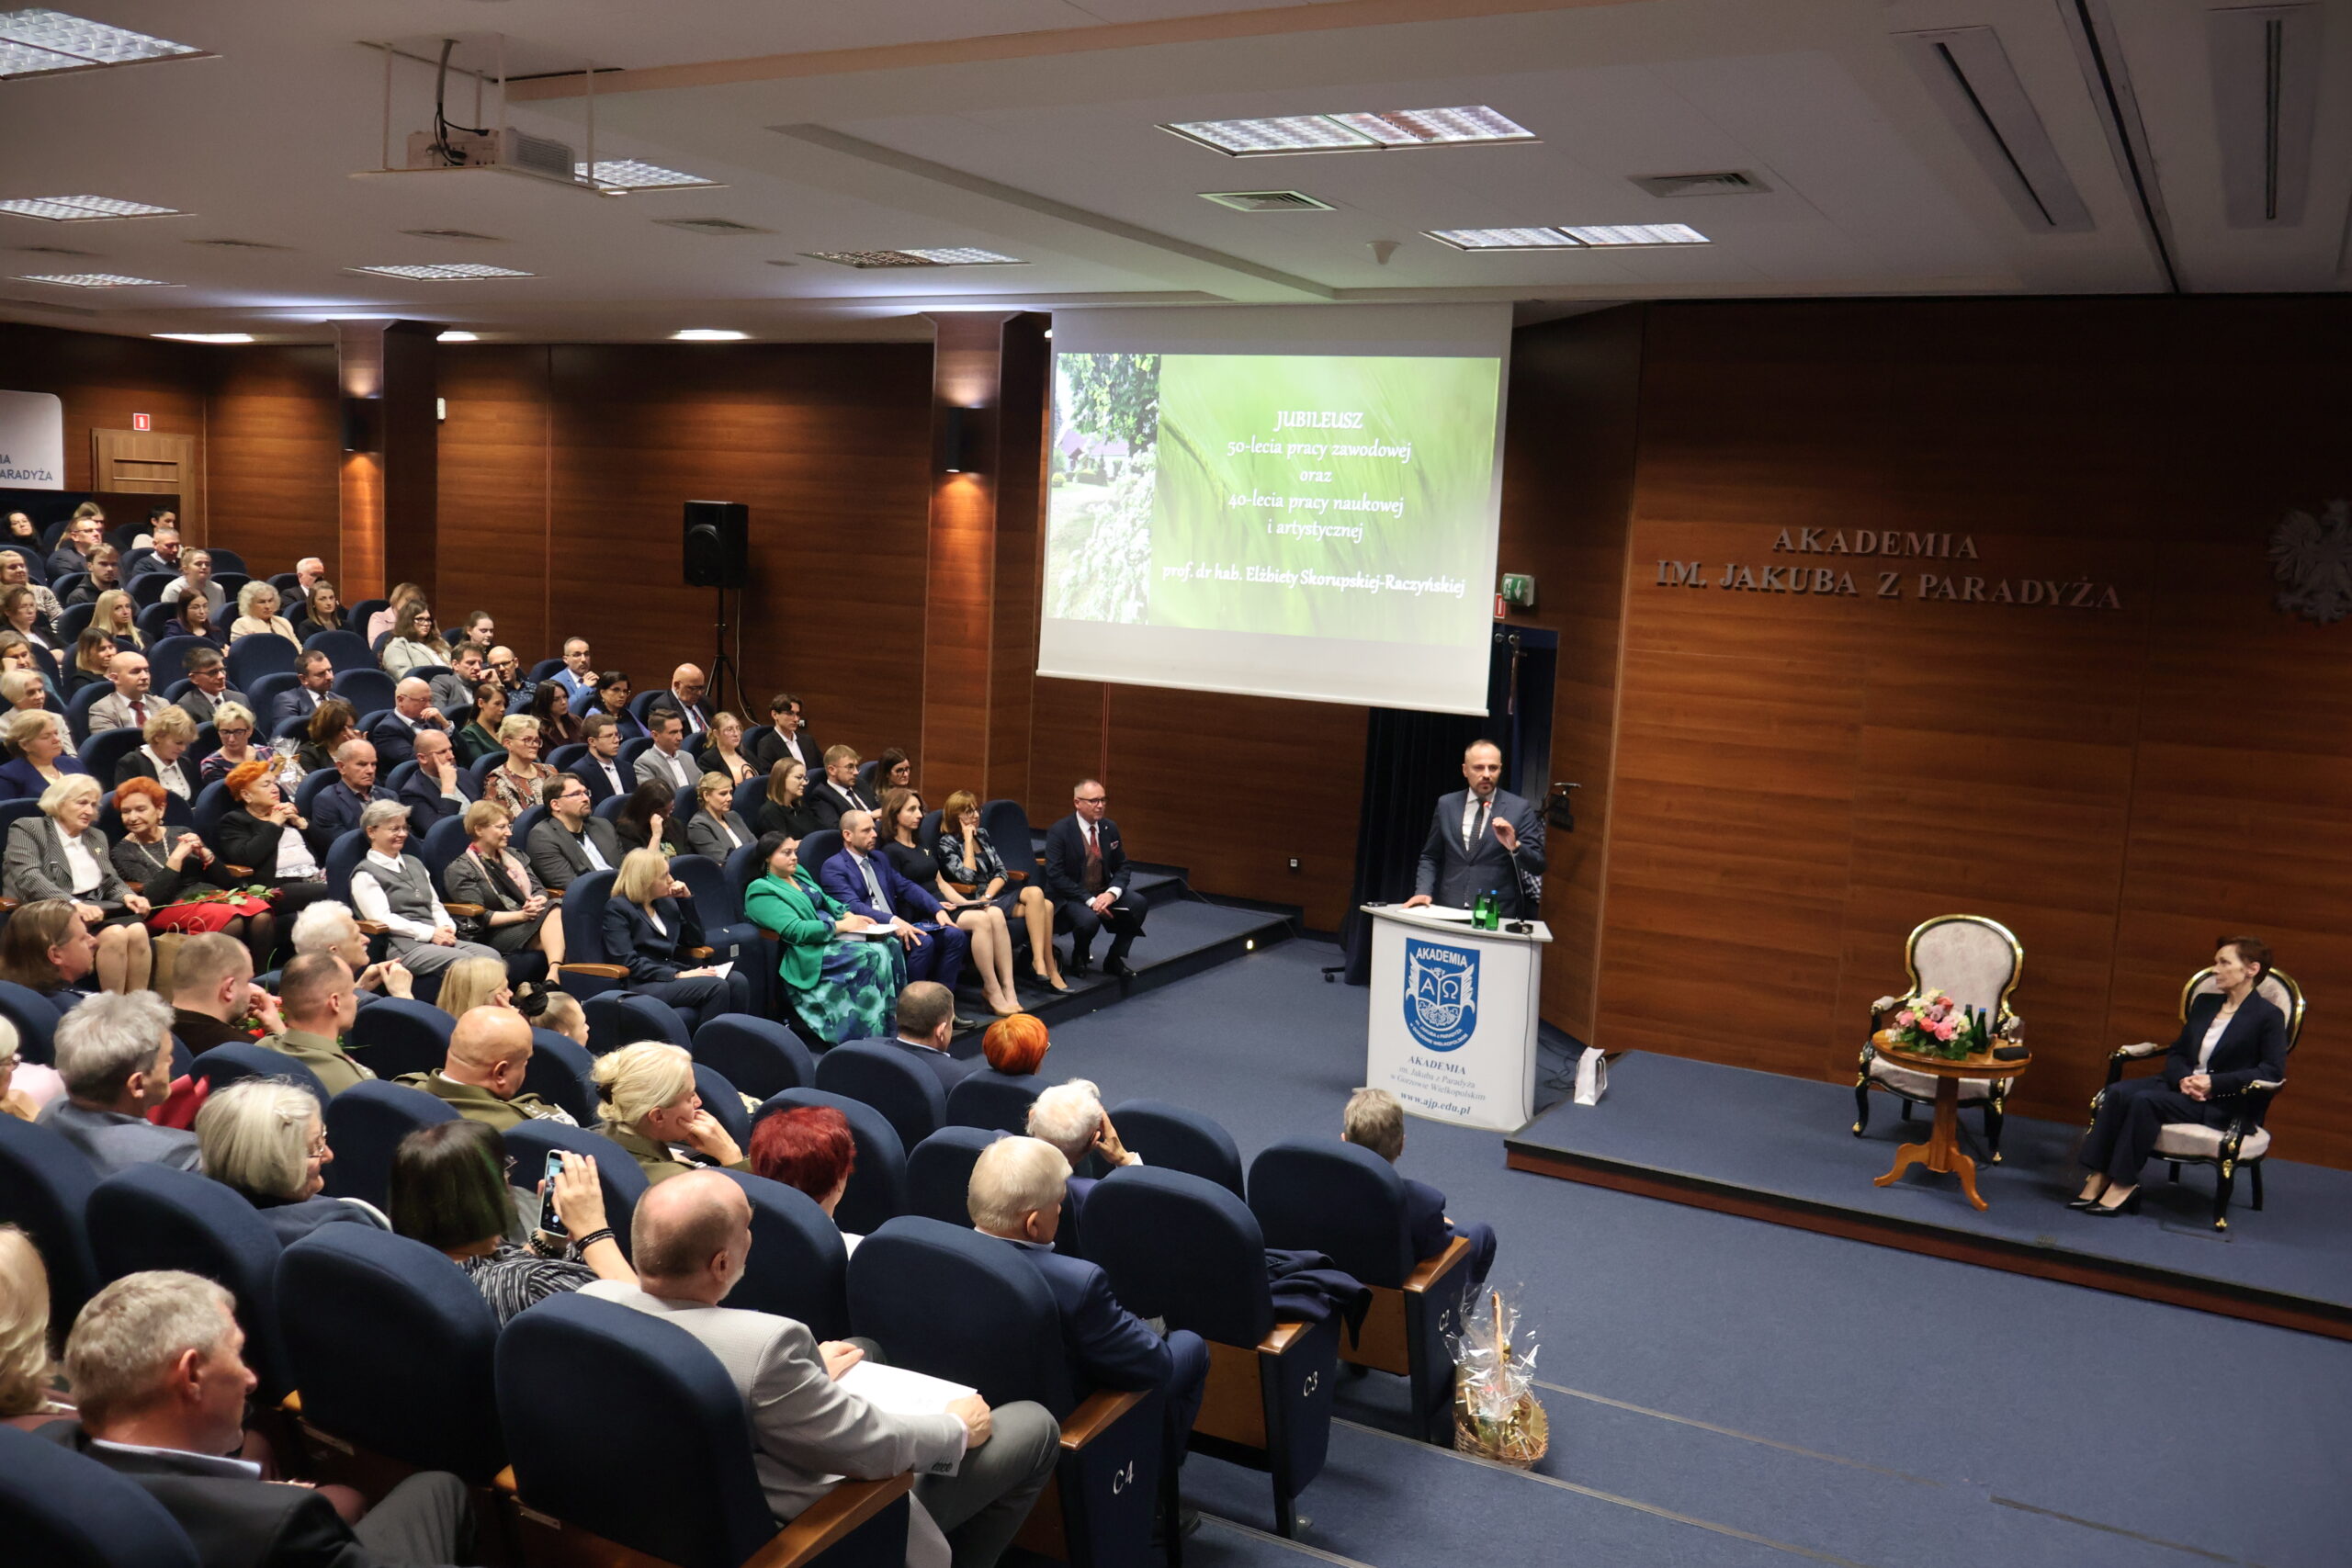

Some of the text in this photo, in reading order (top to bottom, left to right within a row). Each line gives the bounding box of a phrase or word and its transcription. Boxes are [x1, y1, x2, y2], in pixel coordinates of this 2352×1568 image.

[1272, 411, 1364, 432] JUBILEUSZ
[1227, 434, 1411, 464] 50-lecia pracy zawodowej
[1299, 470, 1332, 482] oraz
[1228, 489, 1404, 518] 40-lecia pracy naukowej
[1267, 519, 1363, 544] i artystycznej
[1773, 526, 1979, 559] AKADEMIA
[1162, 561, 1465, 598] prof. dr hab. Elżbiety Skorupskiej-Raczyńskiej
[1657, 559, 2123, 609] IM. JAKUBA Z PARADYŻA
[1416, 947, 1467, 968] AKADEMIA
[1408, 1055, 1466, 1075] AKADEMIA
[1400, 1092, 1471, 1115] www.ajp.edu.pl
[1439, 1309, 1450, 1332] C2
[1303, 1371, 1317, 1397] C3
[1113, 1460, 1133, 1495] C4
